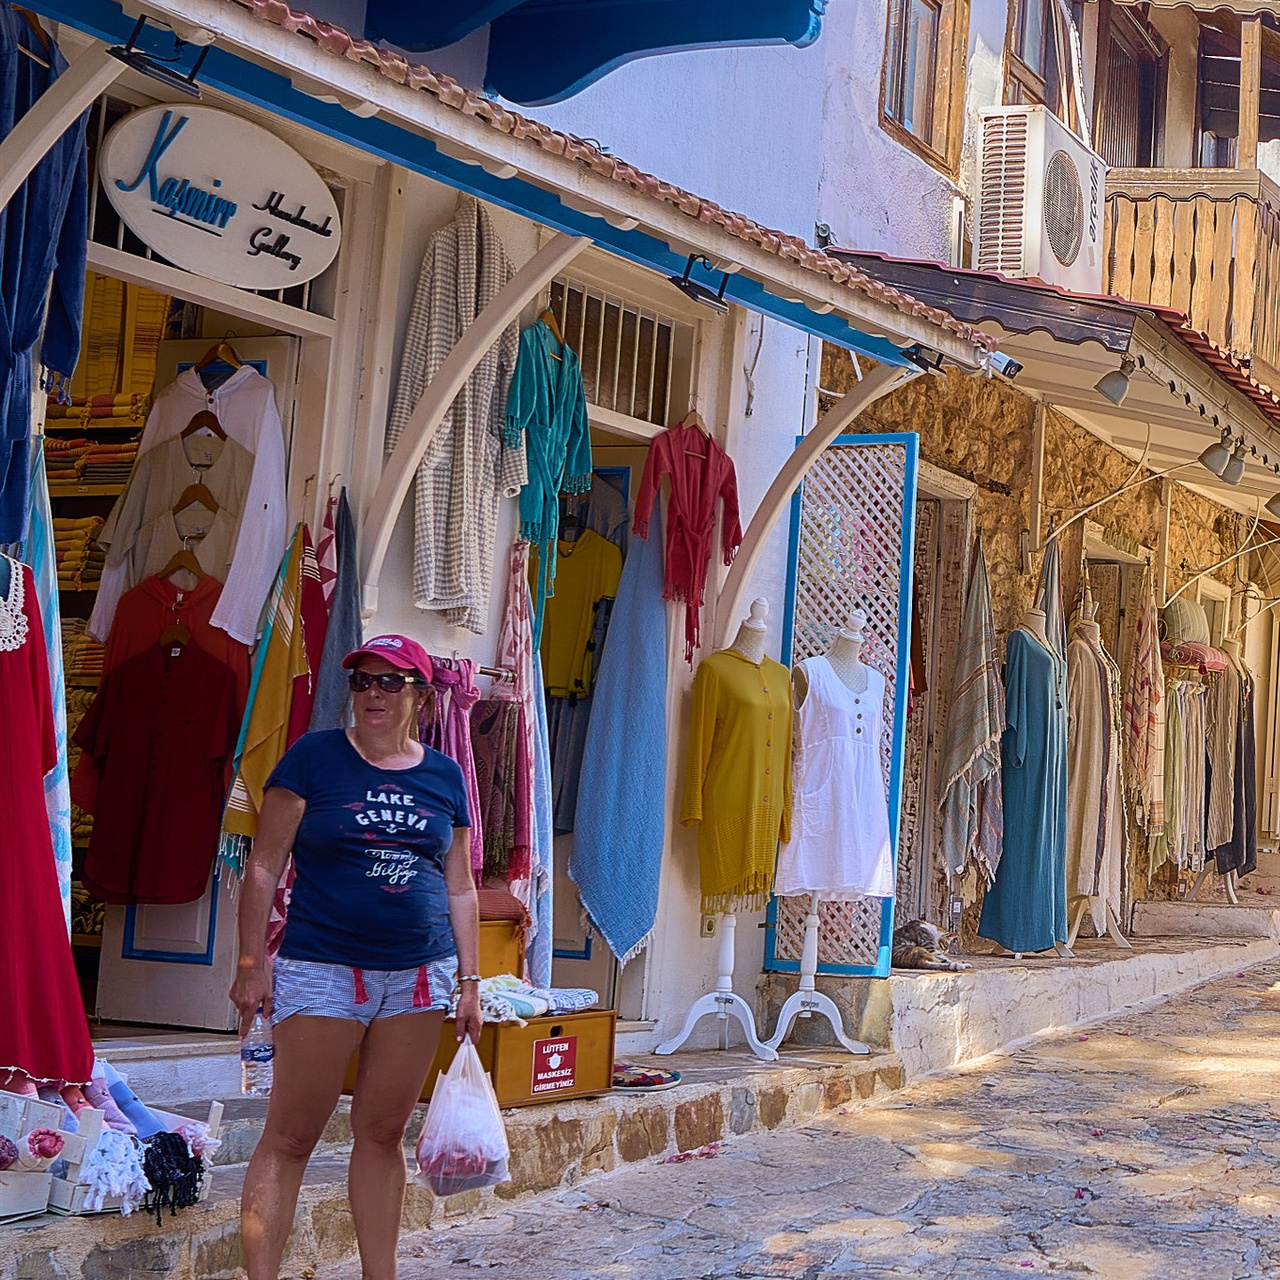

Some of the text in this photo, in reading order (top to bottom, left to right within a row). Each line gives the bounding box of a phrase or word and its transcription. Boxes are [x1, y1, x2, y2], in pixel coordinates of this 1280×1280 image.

[251, 191, 332, 237] Handmade
[246, 227, 302, 271] Gallery
[366, 791, 415, 806] LAKE
[355, 809, 427, 831] GENEVA
[365, 849, 419, 868] Tommy
[542, 1043, 569, 1054] LÜTFEN
[537, 1068, 572, 1080] MASKESİZ
[534, 1079, 574, 1092] GİRMEYİNİZ
